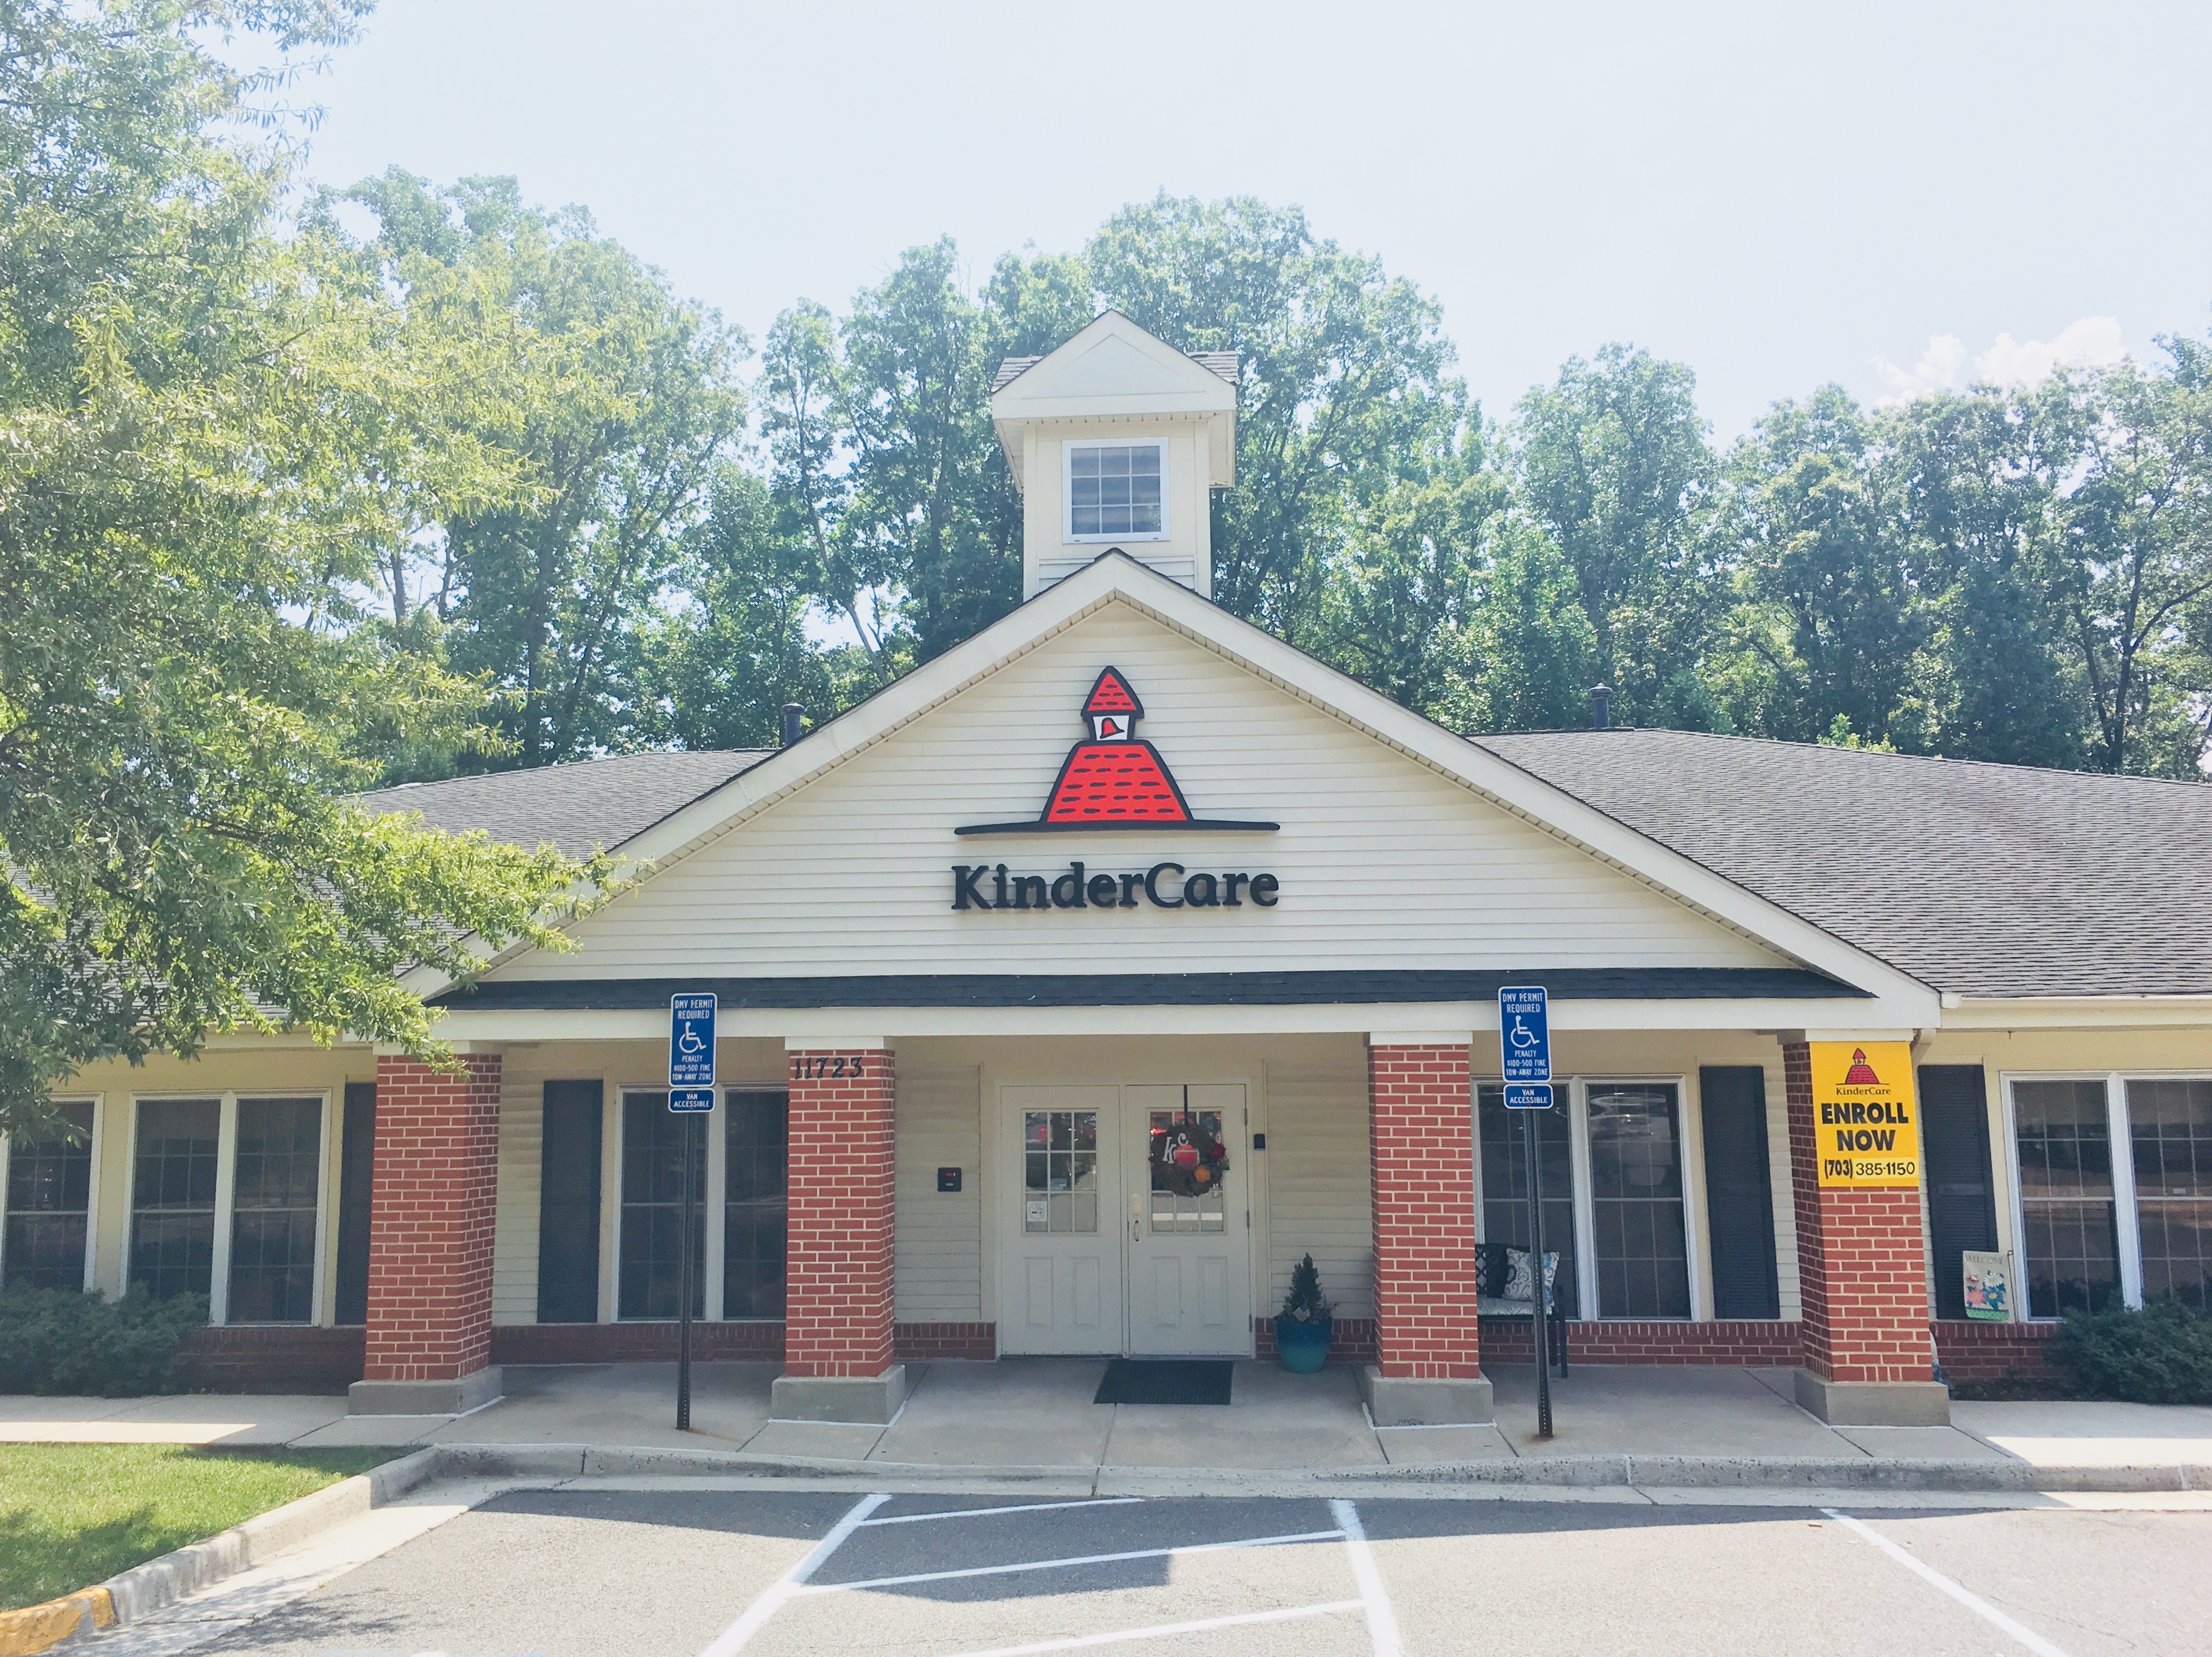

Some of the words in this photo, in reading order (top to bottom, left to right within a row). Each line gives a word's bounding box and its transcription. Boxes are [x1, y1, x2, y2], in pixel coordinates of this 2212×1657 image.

[950, 862, 1280, 910] KinderCare
[1502, 993, 1516, 1002] DMV
[1519, 993, 1543, 1002] PERMIT
[675, 1000, 688, 1009] DMV
[690, 999, 714, 1008] PERMIT
[1507, 1003, 1540, 1013] REQUIRED
[678, 1010, 710, 1019] REQUIRED
[795, 1057, 862, 1079] 11723
[1836, 1087, 1891, 1095] KinderCare
[1821, 1103, 1908, 1124] ENROLL
[1837, 1130, 1896, 1151] NOW
[1825, 1159, 1853, 1180] (703)
[1855, 1162, 1915, 1176] 385-1150
[1965, 1254, 2005, 1264] WELCOME
